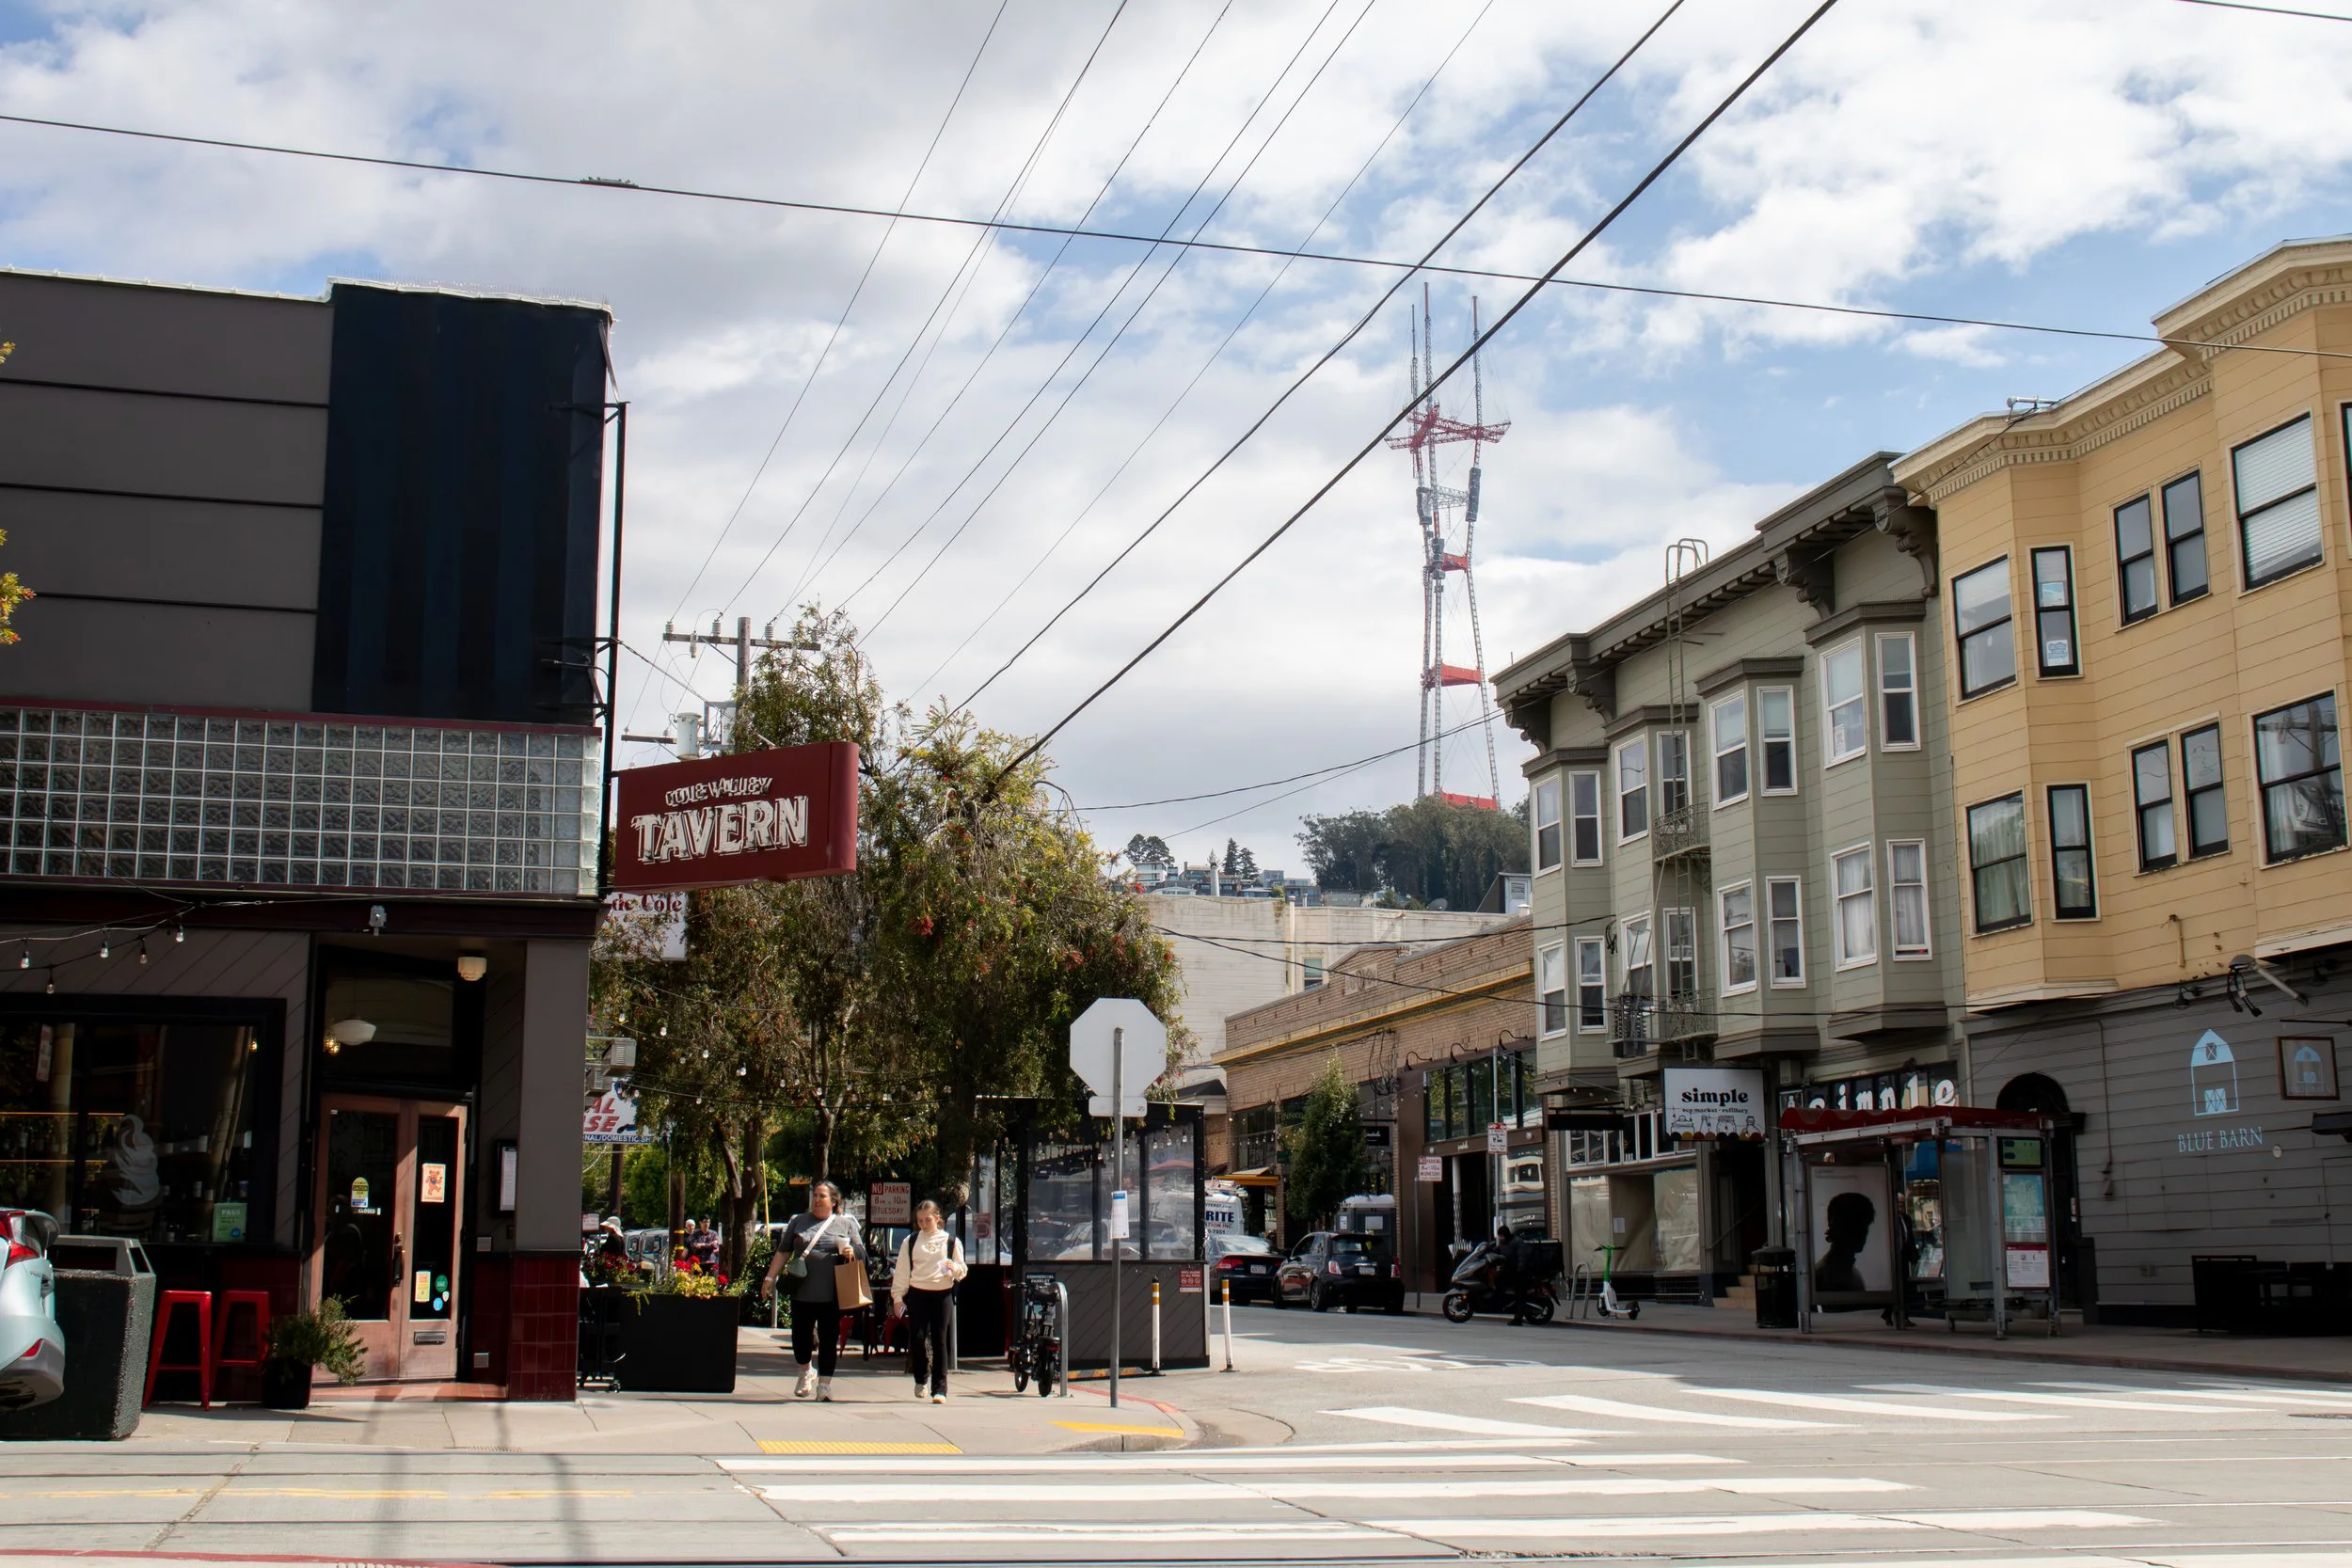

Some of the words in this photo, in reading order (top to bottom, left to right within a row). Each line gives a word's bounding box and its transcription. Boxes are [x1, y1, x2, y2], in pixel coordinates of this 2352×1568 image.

[665, 783, 708, 807] COLE
[708, 777, 773, 798] VALLEY
[631, 796, 808, 864] TAVERN
[642, 893, 683, 912] Cole
[1681, 1086, 1749, 1107] simple
[583, 1116, 620, 1132] SE
[583, 1134, 640, 1143] NAL/DOMESTIC
[2178, 1131, 2214, 1152] BLUE
[2220, 1127, 2263, 1148] BARN
[871, 1182, 883, 1195] NO
[885, 1185, 910, 1194] PARKING
[1205, 1211, 1234, 1223] RITE
